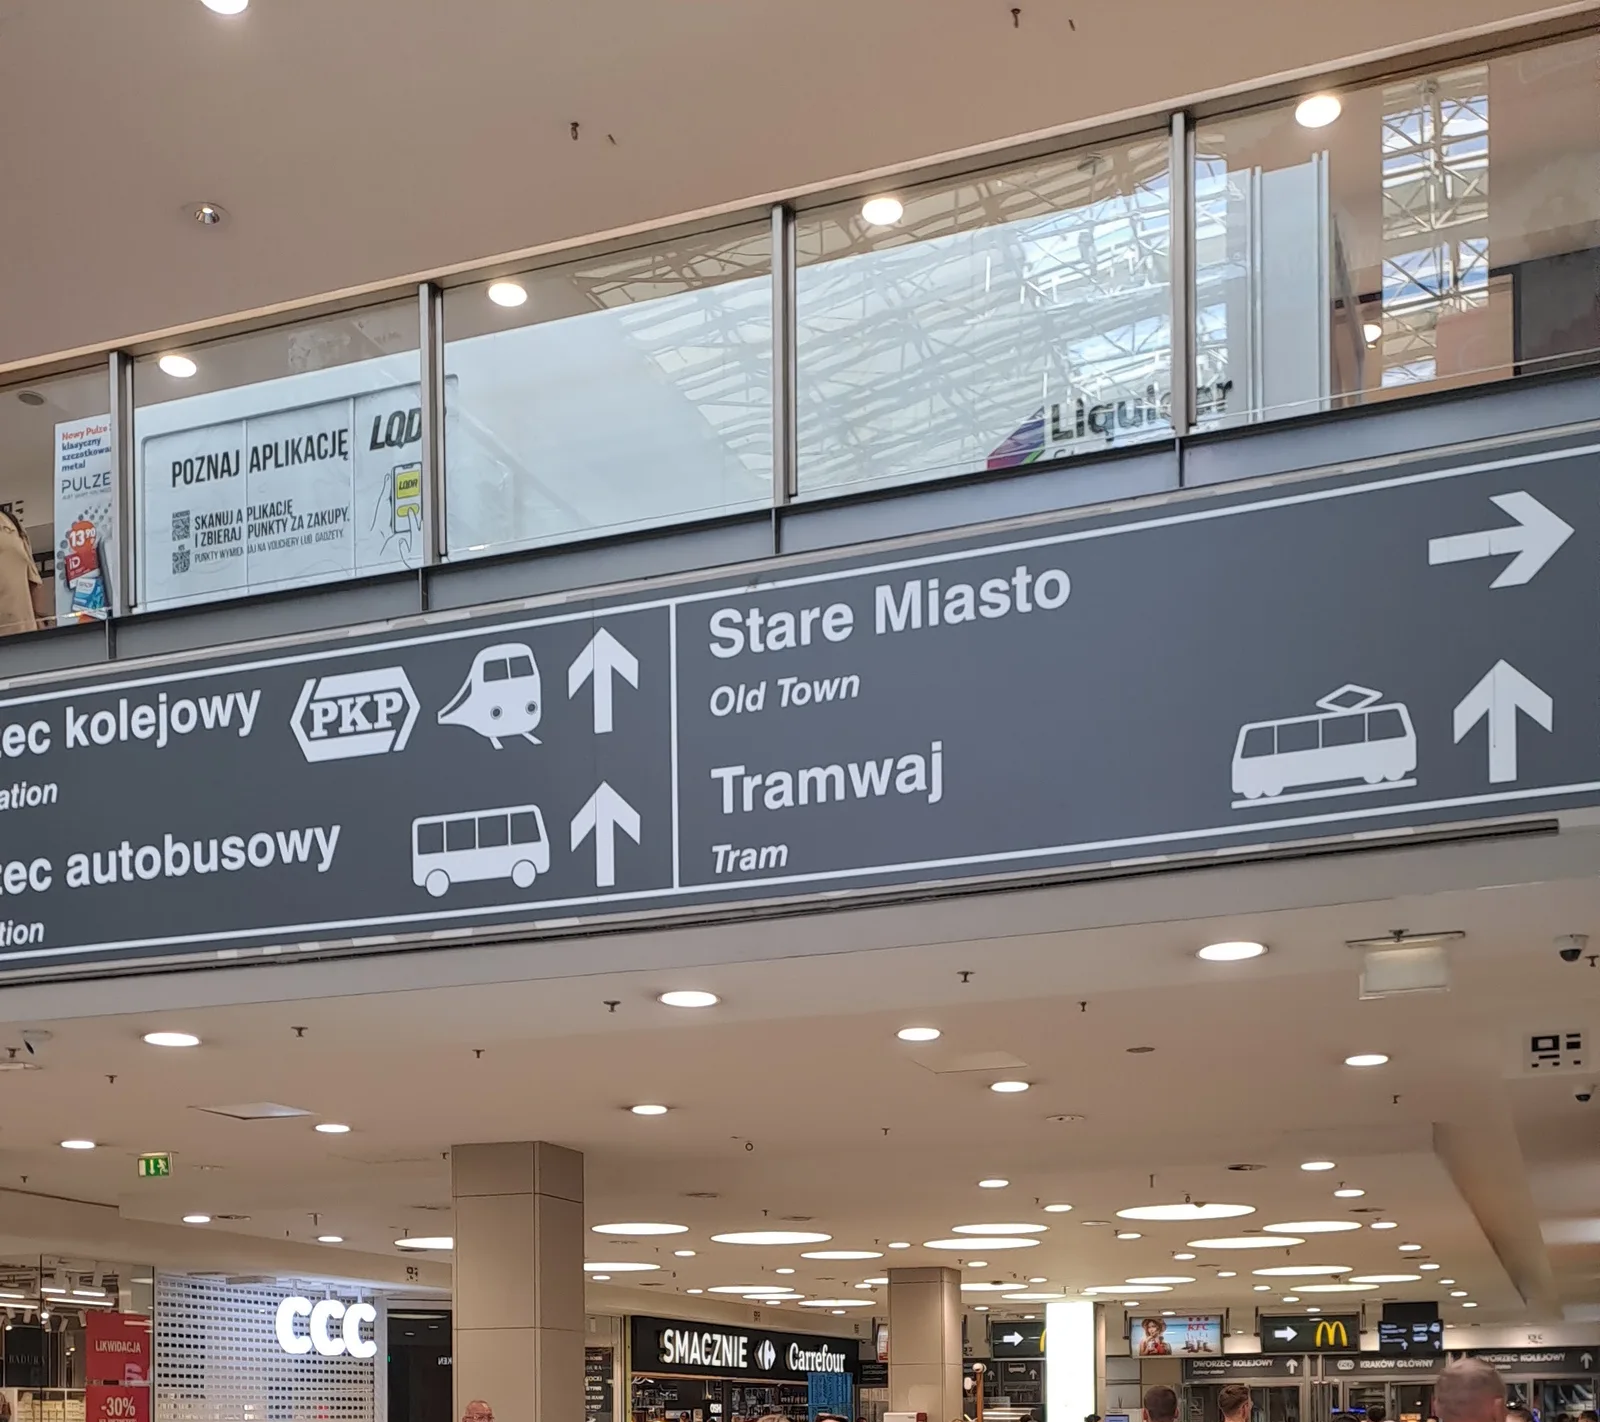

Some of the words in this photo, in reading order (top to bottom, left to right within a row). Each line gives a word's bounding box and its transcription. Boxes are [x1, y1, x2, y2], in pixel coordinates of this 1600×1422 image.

[62, 430, 85, 441] Nowy
[62, 437, 101, 451] klasyczny
[61, 459, 86, 472] metal
[172, 449, 240, 488] POZNAJ
[249, 428, 349, 474] APLIKACJĘ
[62, 470, 111, 494] PULZE
[194, 510, 233, 530] SKANUJ
[201, 526, 242, 548] ZBIERAJ
[247, 518, 288, 539] PUNKTY
[290, 515, 304, 532] ZA
[708, 600, 855, 659] Stare
[874, 565, 1072, 635] Miasto
[709, 681, 766, 717] Old
[777, 674, 860, 708] Town
[0, 720, 51, 758] ec
[65, 689, 262, 749] kolejowy
[309, 692, 404, 740] PKP
[710, 740, 943, 815] Tramwaj
[0, 857, 53, 895] ec
[65, 824, 341, 889] autobusowy
[711, 843, 789, 874] Tram
[275, 1296, 378, 1359] CCC
[95, 1340, 141, 1353] LIKWIDACJA
[662, 1328, 749, 1368] SMACZNIE
[788, 1341, 846, 1373] Carrefour
[1193, 1359, 1231, 1368] DWORZEC
[1233, 1359, 1274, 1367] KOLEJOWY
[1360, 1358, 1394, 1368] KRAKÓW
[1396, 1358, 1434, 1368] GŁÓWNY
[101, 1396, 136, 1417] -30%
